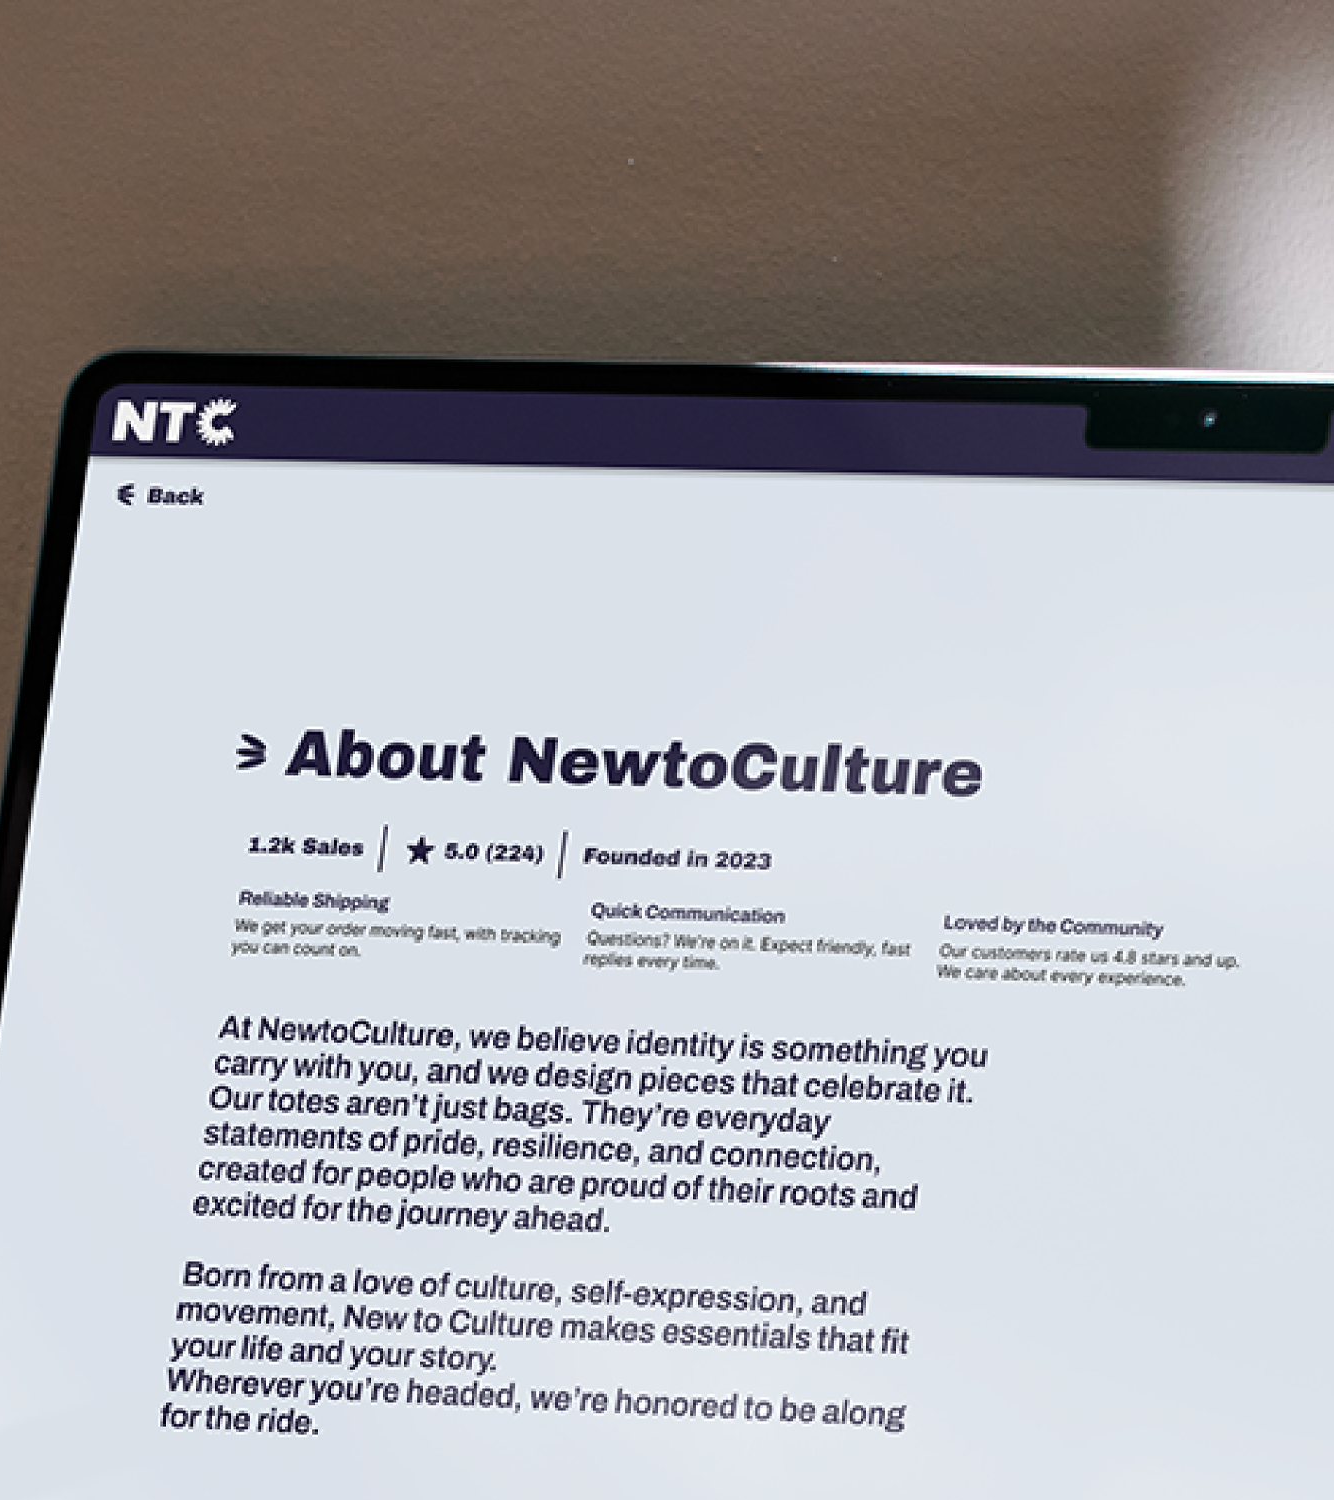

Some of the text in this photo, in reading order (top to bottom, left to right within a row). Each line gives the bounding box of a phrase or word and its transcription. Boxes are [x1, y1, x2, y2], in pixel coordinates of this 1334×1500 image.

[111, 399, 237, 446] NTC
[146, 485, 206, 507] Back
[284, 728, 984, 799] About NewtoCulture
[247, 836, 365, 858] 1.2k Sales
[443, 841, 546, 866] 5.0 (224)
[581, 847, 774, 871] Founded in 2023
[238, 888, 392, 915] Reliable Shipping
[590, 901, 787, 925] Quick Communication
[235, 917, 563, 950] We get your order moving fast, with tracking
[584, 928, 672, 950] Questions?
[719, 936, 741, 953] on
[741, 936, 756, 952] it.
[759, 936, 814, 956] Expect
[816, 937, 878, 959] friendly,
[881, 939, 913, 958] fast
[943, 914, 1165, 942] Loved by the Community
[230, 939, 362, 958] you can count on.
[581, 952, 721, 973] replies every time.
[938, 942, 1241, 972] Our customers rate us 4.8 stars and up.
[935, 963, 1186, 988] We care about every experience.
[217, 1014, 990, 1074] At NewtoCulture, we believe identity is something you
[214, 1052, 974, 1105] carry with you, and we design pieces that celebrate it.
[208, 1083, 833, 1142] Our totes aren't just bags. They're everyday
[202, 1120, 881, 1179] statements of pride, resilience, and connection,
[197, 1158, 920, 1212] created for people who are proud of their roots and
[192, 1190, 611, 1236] excited for the journey ahead.
[182, 1260, 870, 1320] Born from a love of culture, self-expression, and
[175, 1301, 911, 1356] movement, New to Culture makes essentials that fit
[168, 1333, 498, 1379] your life and your story.
[165, 1366, 908, 1434] Wherever you're headed, we're honored to be along
[159, 1401, 320, 1437] for the ride.
